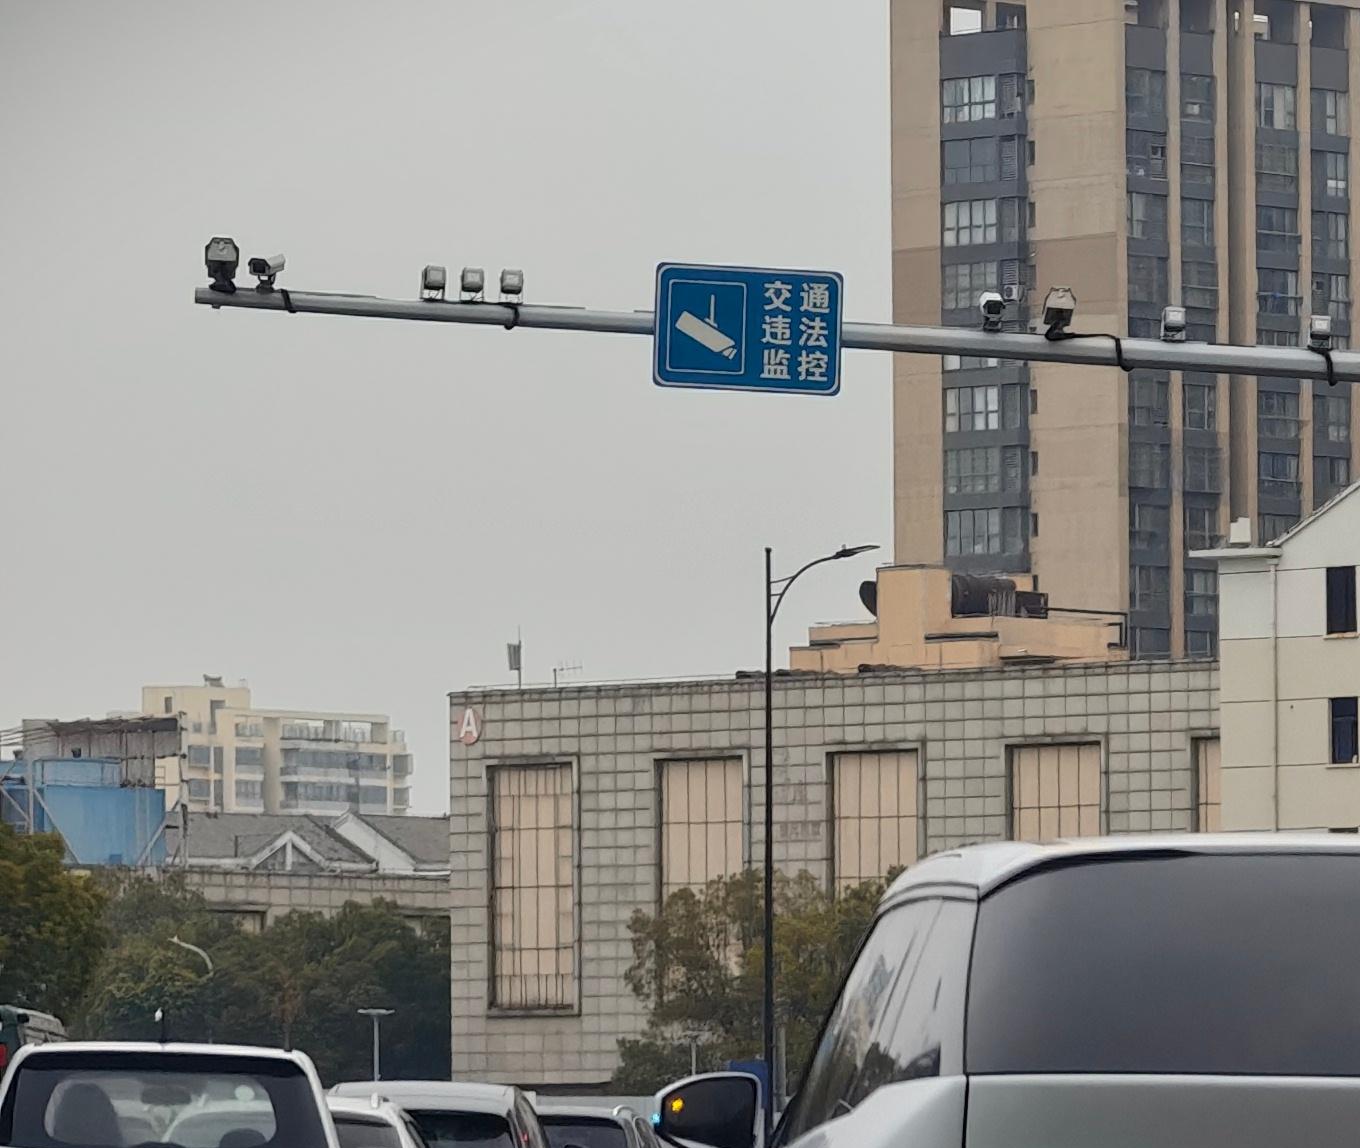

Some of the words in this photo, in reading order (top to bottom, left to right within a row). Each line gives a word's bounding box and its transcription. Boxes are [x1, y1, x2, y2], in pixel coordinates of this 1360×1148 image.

[763, 281, 830, 314] 交通
[761, 315, 829, 348] 违法
[760, 350, 828, 382] 监控
[459, 707, 478, 738] A
